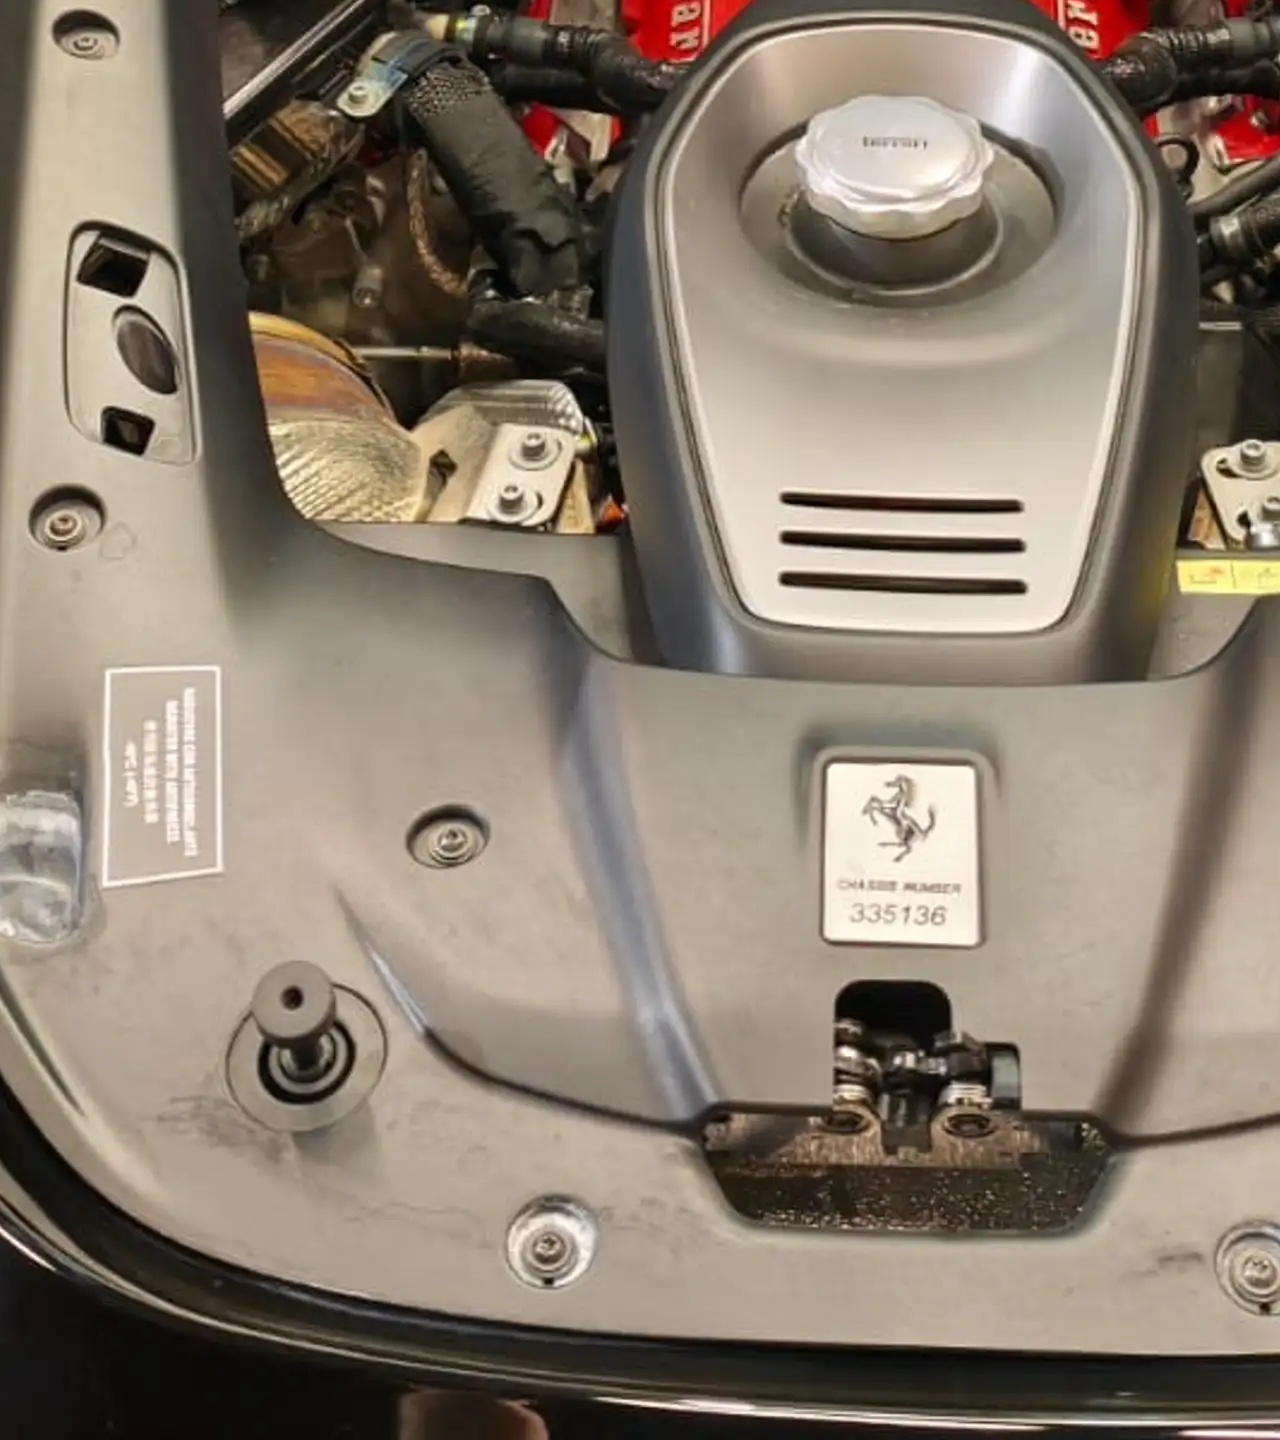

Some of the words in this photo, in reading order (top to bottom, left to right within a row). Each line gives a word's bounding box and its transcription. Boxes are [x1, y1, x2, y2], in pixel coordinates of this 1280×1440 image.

[837, 878, 897, 893] CHASSIS
[902, 881, 961, 895] NUMBER
[849, 902, 948, 927] 335136
